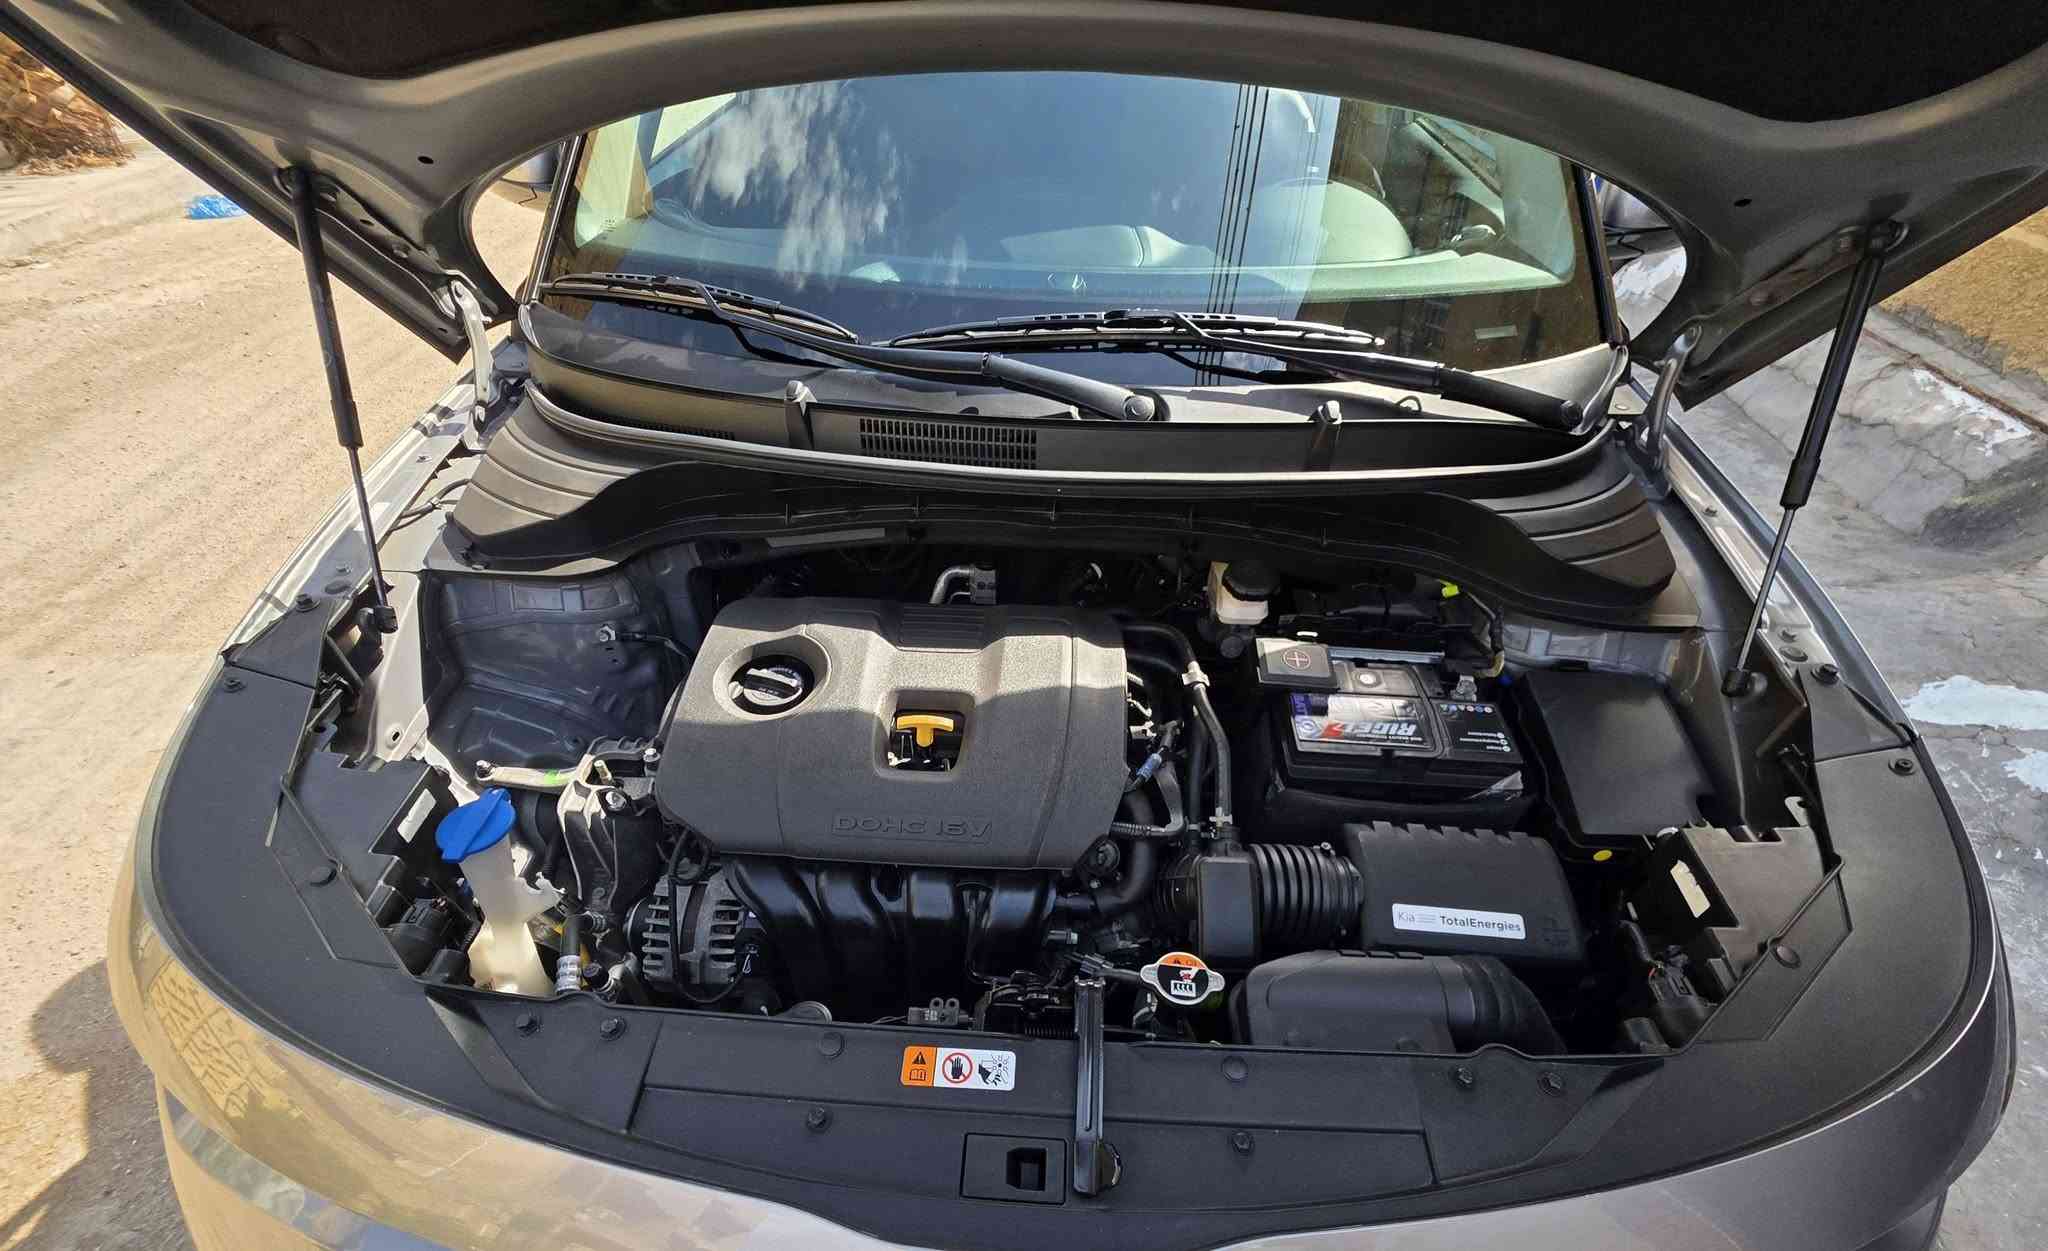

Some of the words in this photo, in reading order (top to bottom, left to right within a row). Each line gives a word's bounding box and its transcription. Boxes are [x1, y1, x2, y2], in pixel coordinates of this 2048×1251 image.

[832, 815, 928, 834] DOHC
[1399, 911, 1415, 922] Kia
[1440, 915, 1521, 932] TotalEnergies
